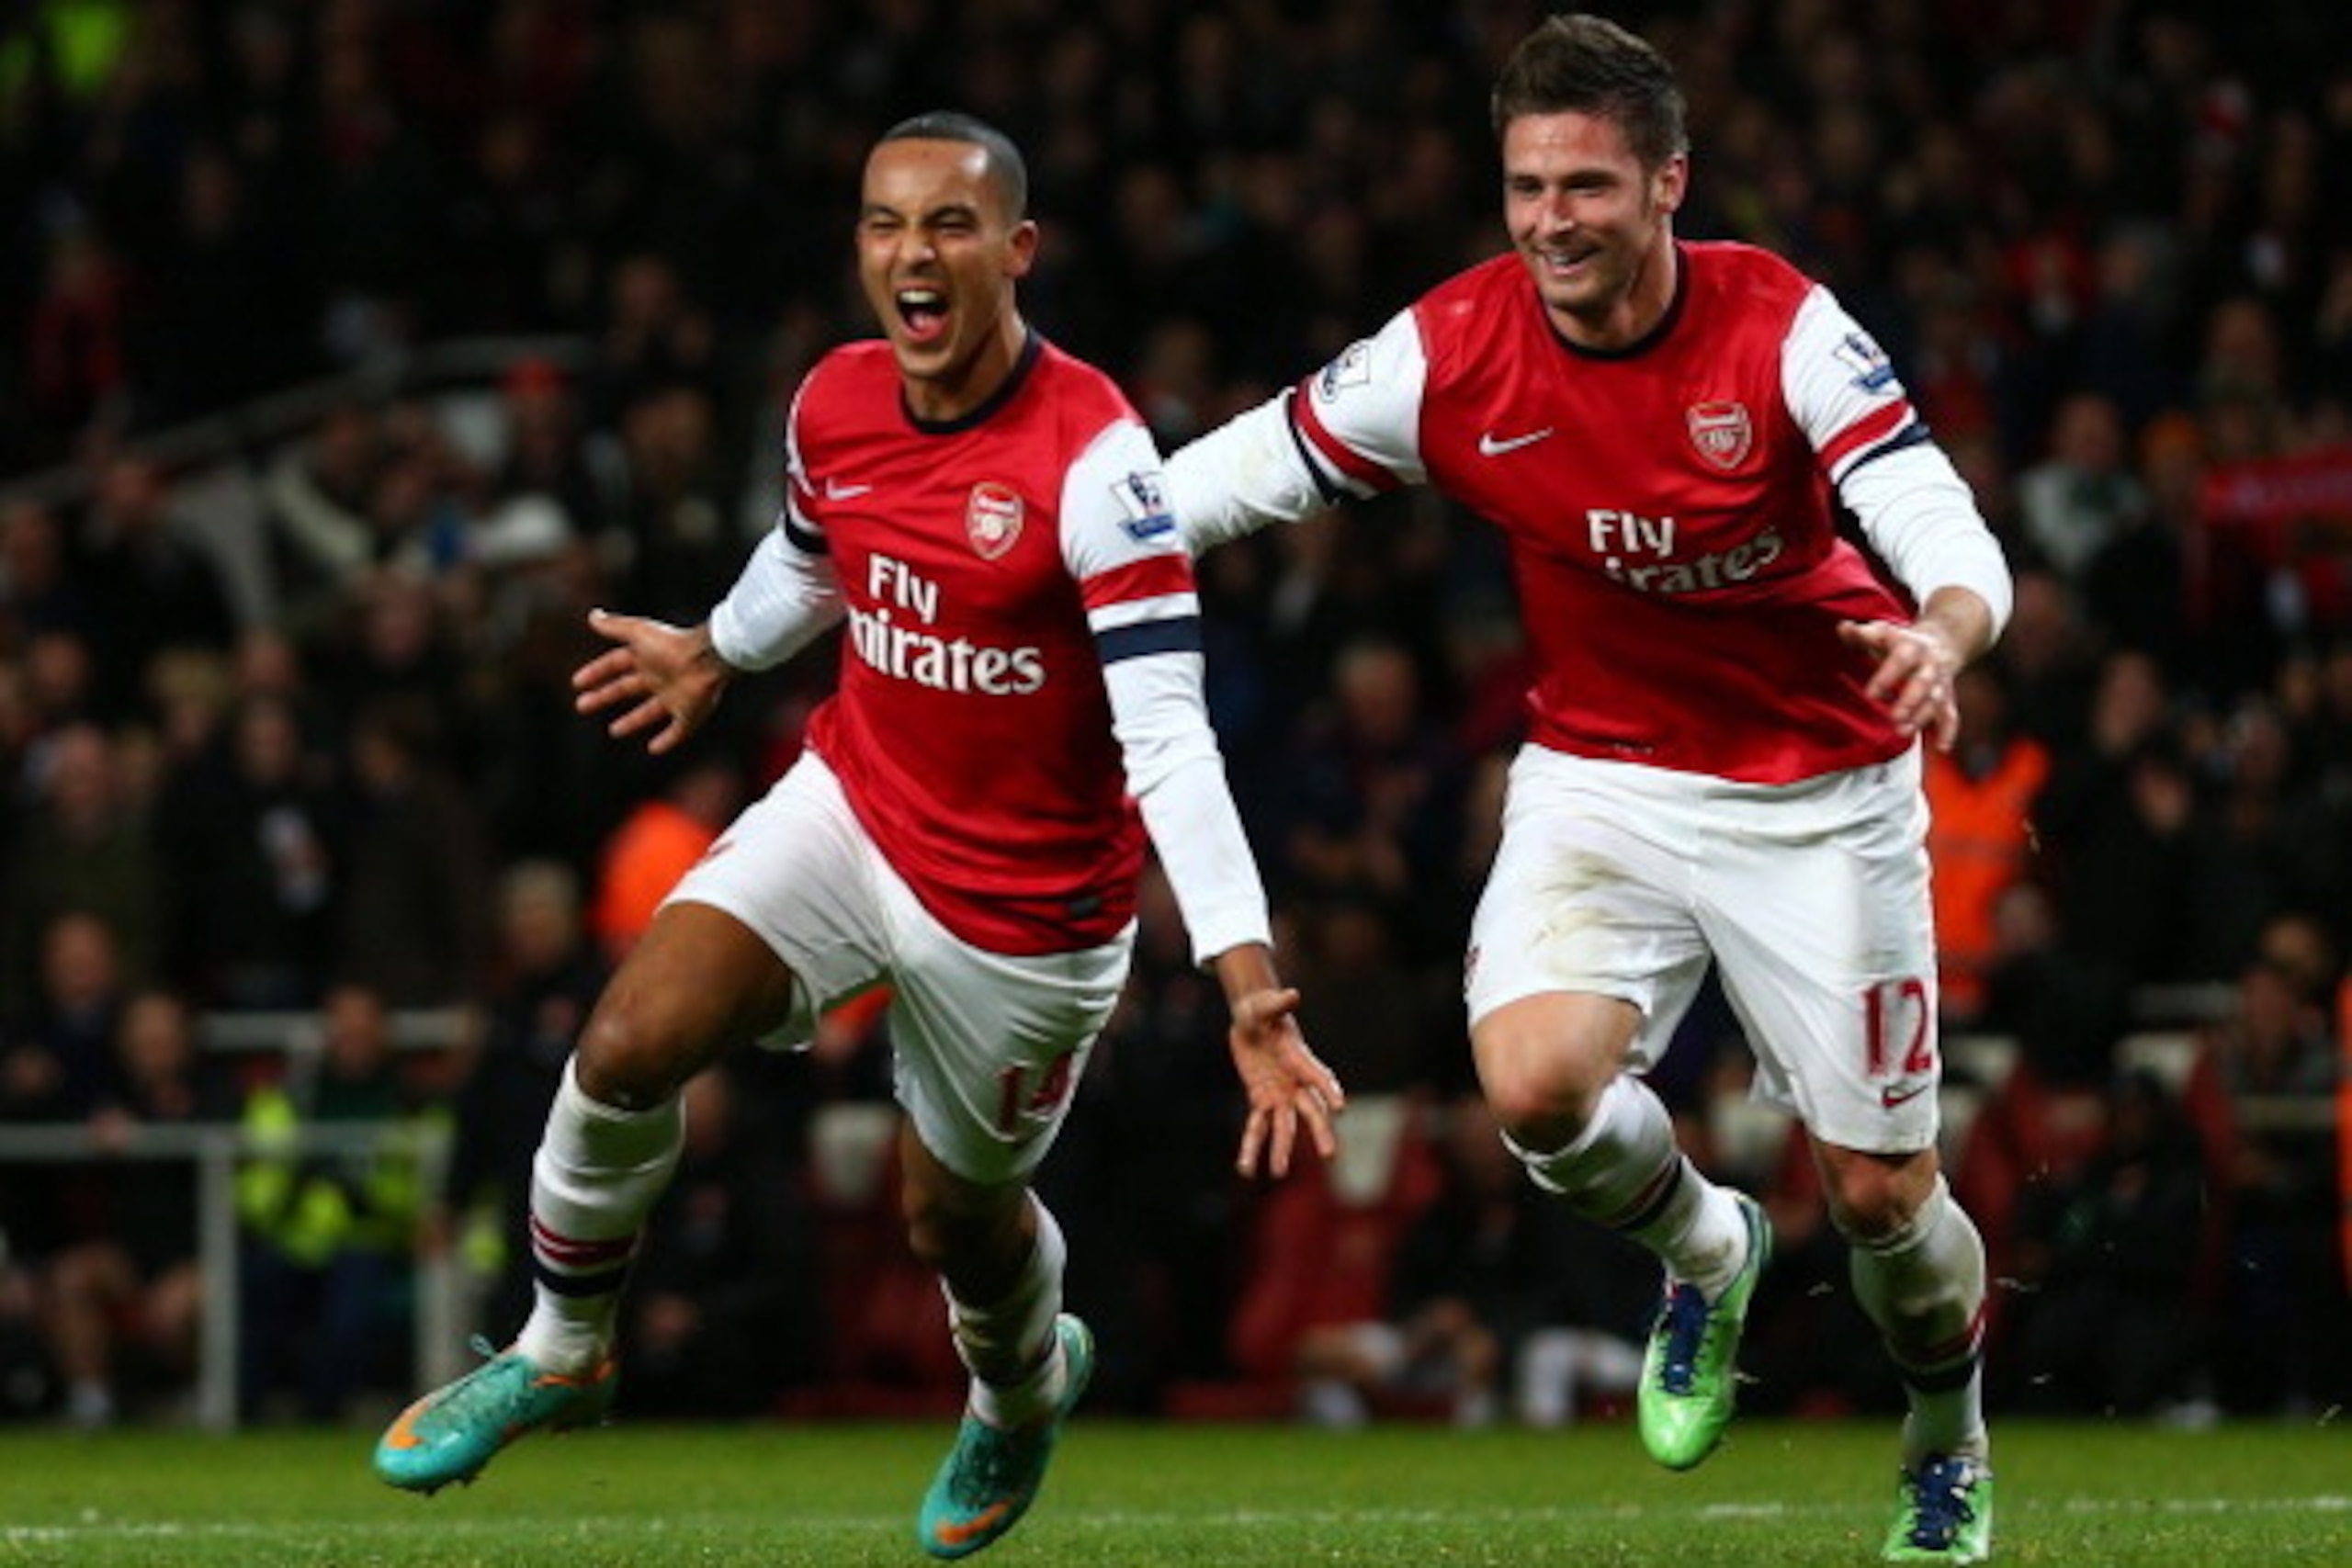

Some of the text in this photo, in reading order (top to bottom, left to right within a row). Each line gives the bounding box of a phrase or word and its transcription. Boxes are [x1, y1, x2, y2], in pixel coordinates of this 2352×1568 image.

[1586, 508, 1674, 558] Fly
[869, 552, 937, 625] Fly
[848, 604, 1046, 696] mirates
[1861, 978, 1932, 1077] 12
[995, 1054, 1070, 1136] 14
